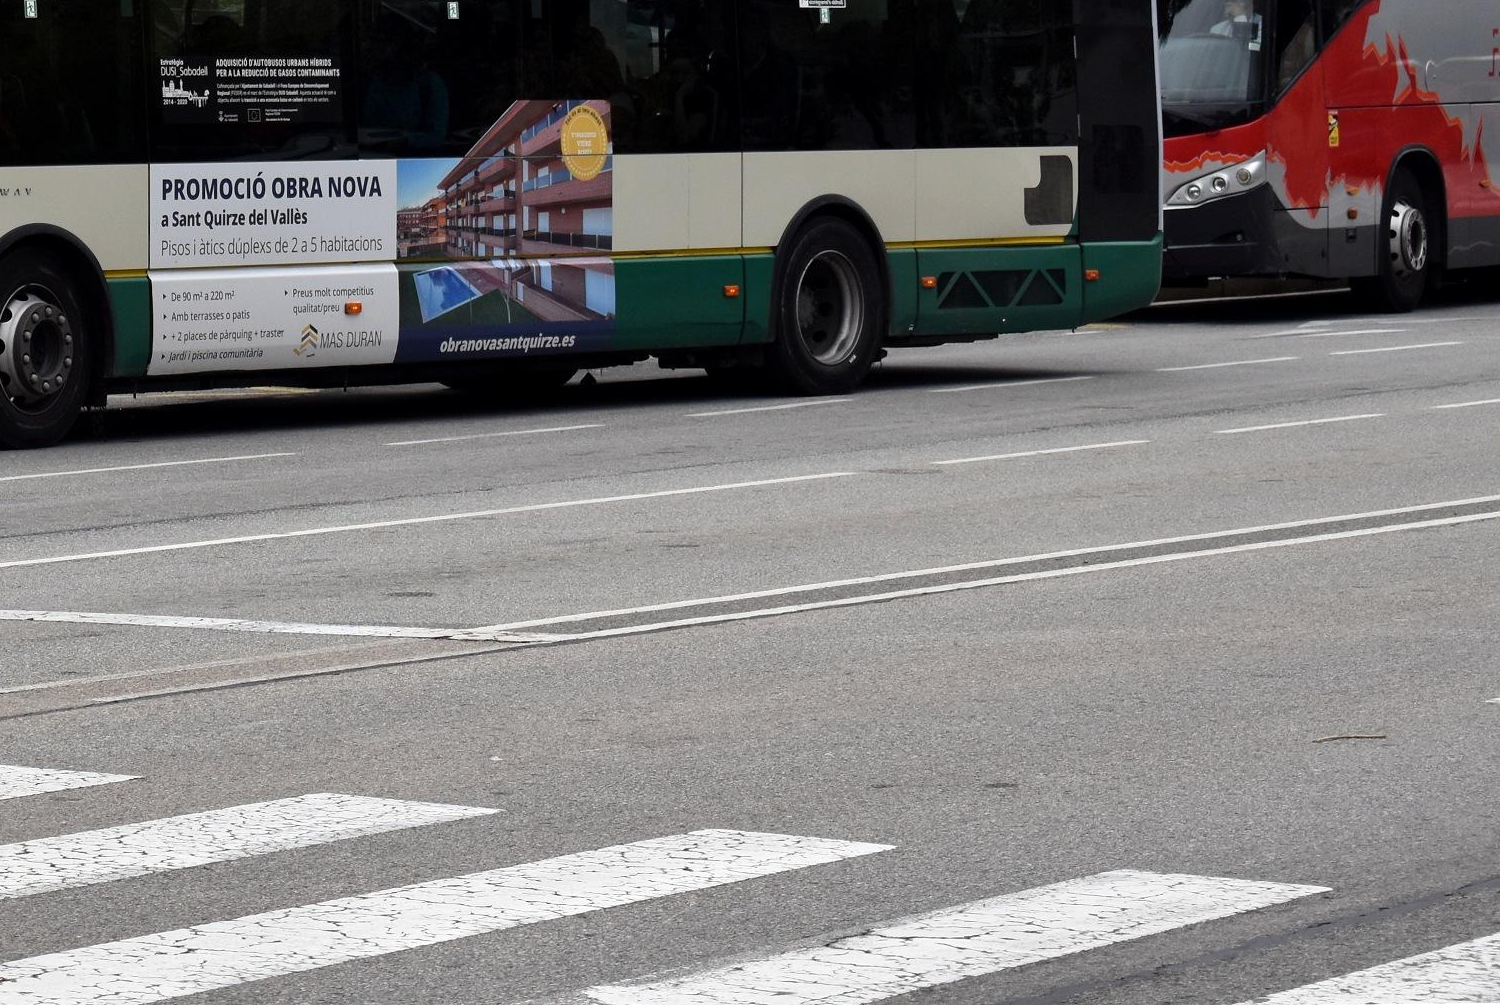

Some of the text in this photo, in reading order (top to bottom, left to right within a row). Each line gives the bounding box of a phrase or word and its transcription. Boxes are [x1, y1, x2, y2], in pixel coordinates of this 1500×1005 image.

[215, 57, 332, 67] ADQUISICIÓ D'AUTOBUSOS URBANS HÍBRIDS
[216, 68, 340, 77] PER A LA REDUCCIÓ DE GASOS CONTAMINANTS
[162, 172, 382, 200] PROMOCIÓ OBRA NOVA
[161, 208, 308, 230] a Sant Quirze del Vallès
[161, 235, 383, 259] Pisos i àtics dúplexs de 2 a 5 habitacions
[171, 293, 181, 302] De
[182, 292, 191, 301] 90
[211, 291, 223, 301] 220
[292, 286, 374, 298] Preus molt competitius
[171, 310, 250, 322] Amb terrasses o patis
[293, 303, 340, 315] qualitat/preu
[177, 332, 183, 342] 2
[184, 330, 207, 343] places
[208, 330, 218, 340] de
[220, 329, 252, 342] pàrquing
[260, 329, 284, 339] traster
[320, 331, 382, 349] MAS DURAN
[440, 332, 576, 353] obranovasantquirze.es
[192, 351, 218, 364] piscina
[219, 348, 264, 359] comunitària
